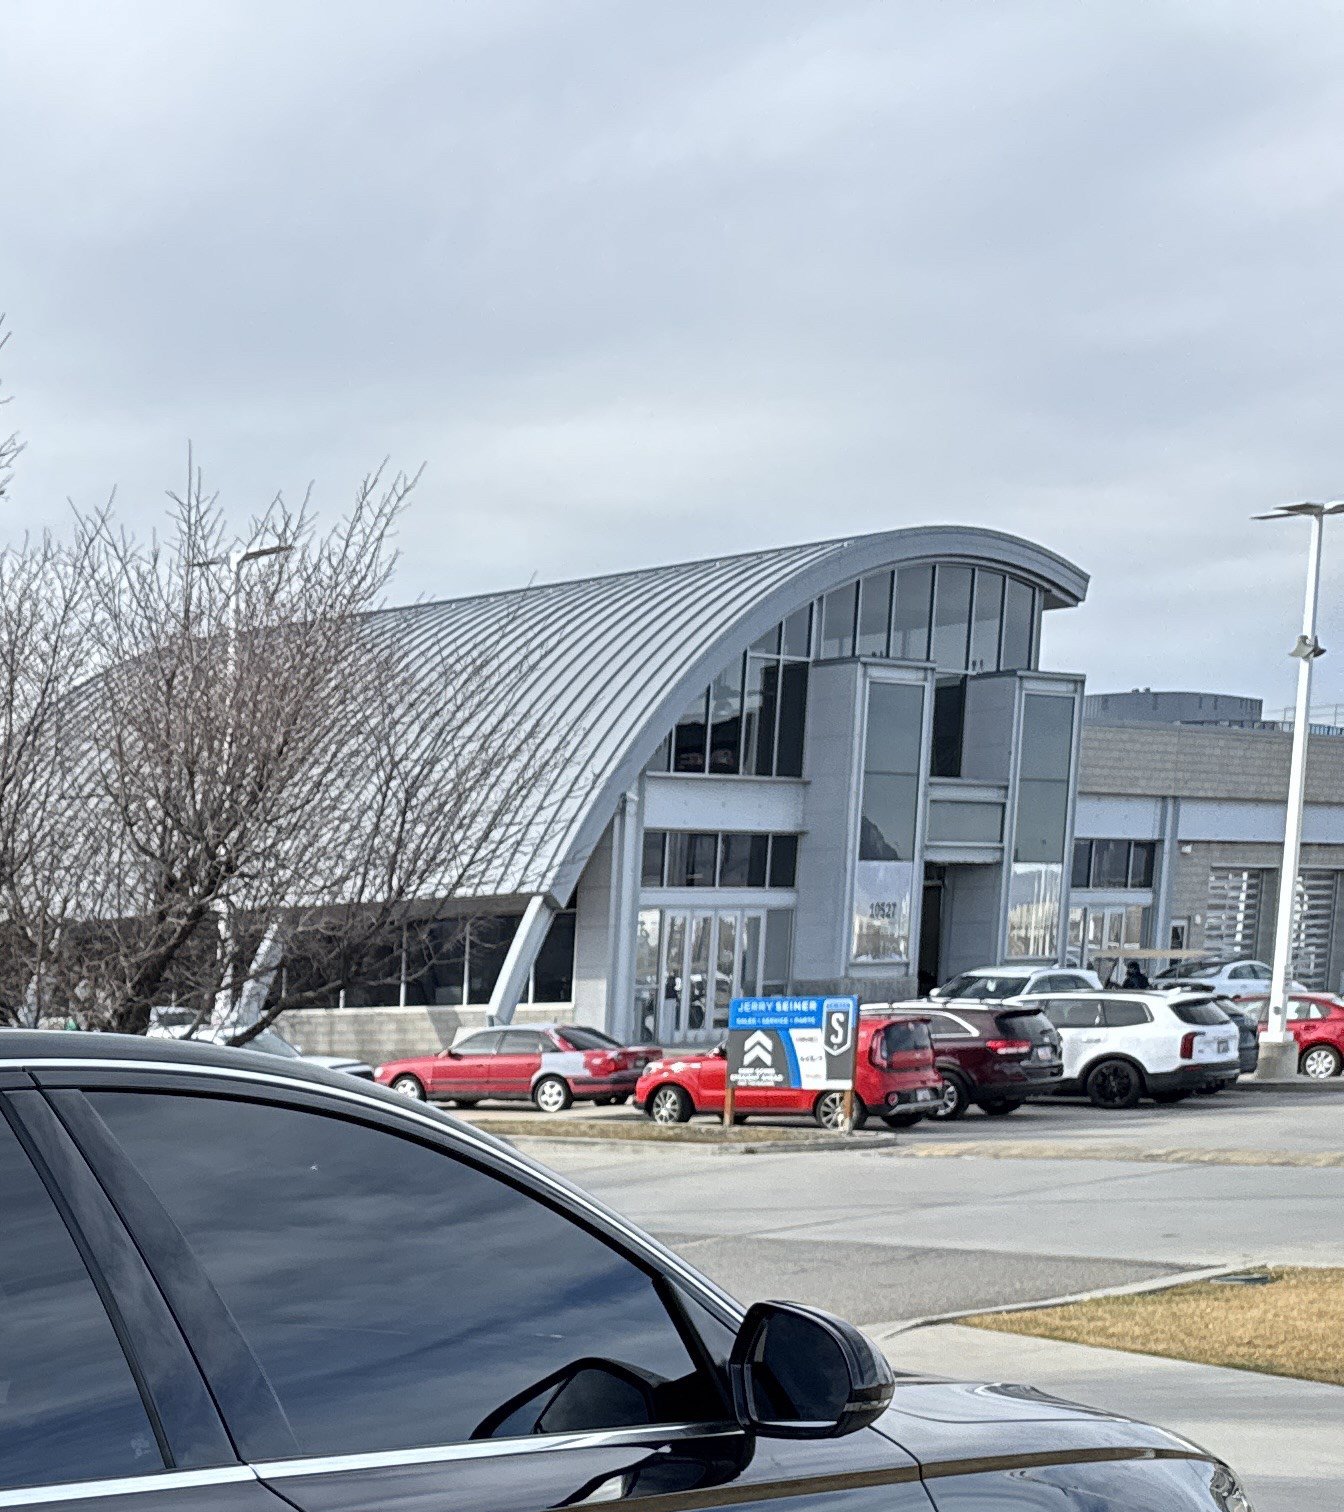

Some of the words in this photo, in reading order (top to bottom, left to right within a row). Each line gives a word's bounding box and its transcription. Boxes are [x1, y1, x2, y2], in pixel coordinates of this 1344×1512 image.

[869, 902, 897, 918] 10527
[737, 1001, 773, 1012] JERRY
[775, 1000, 817, 1012] SEINER
